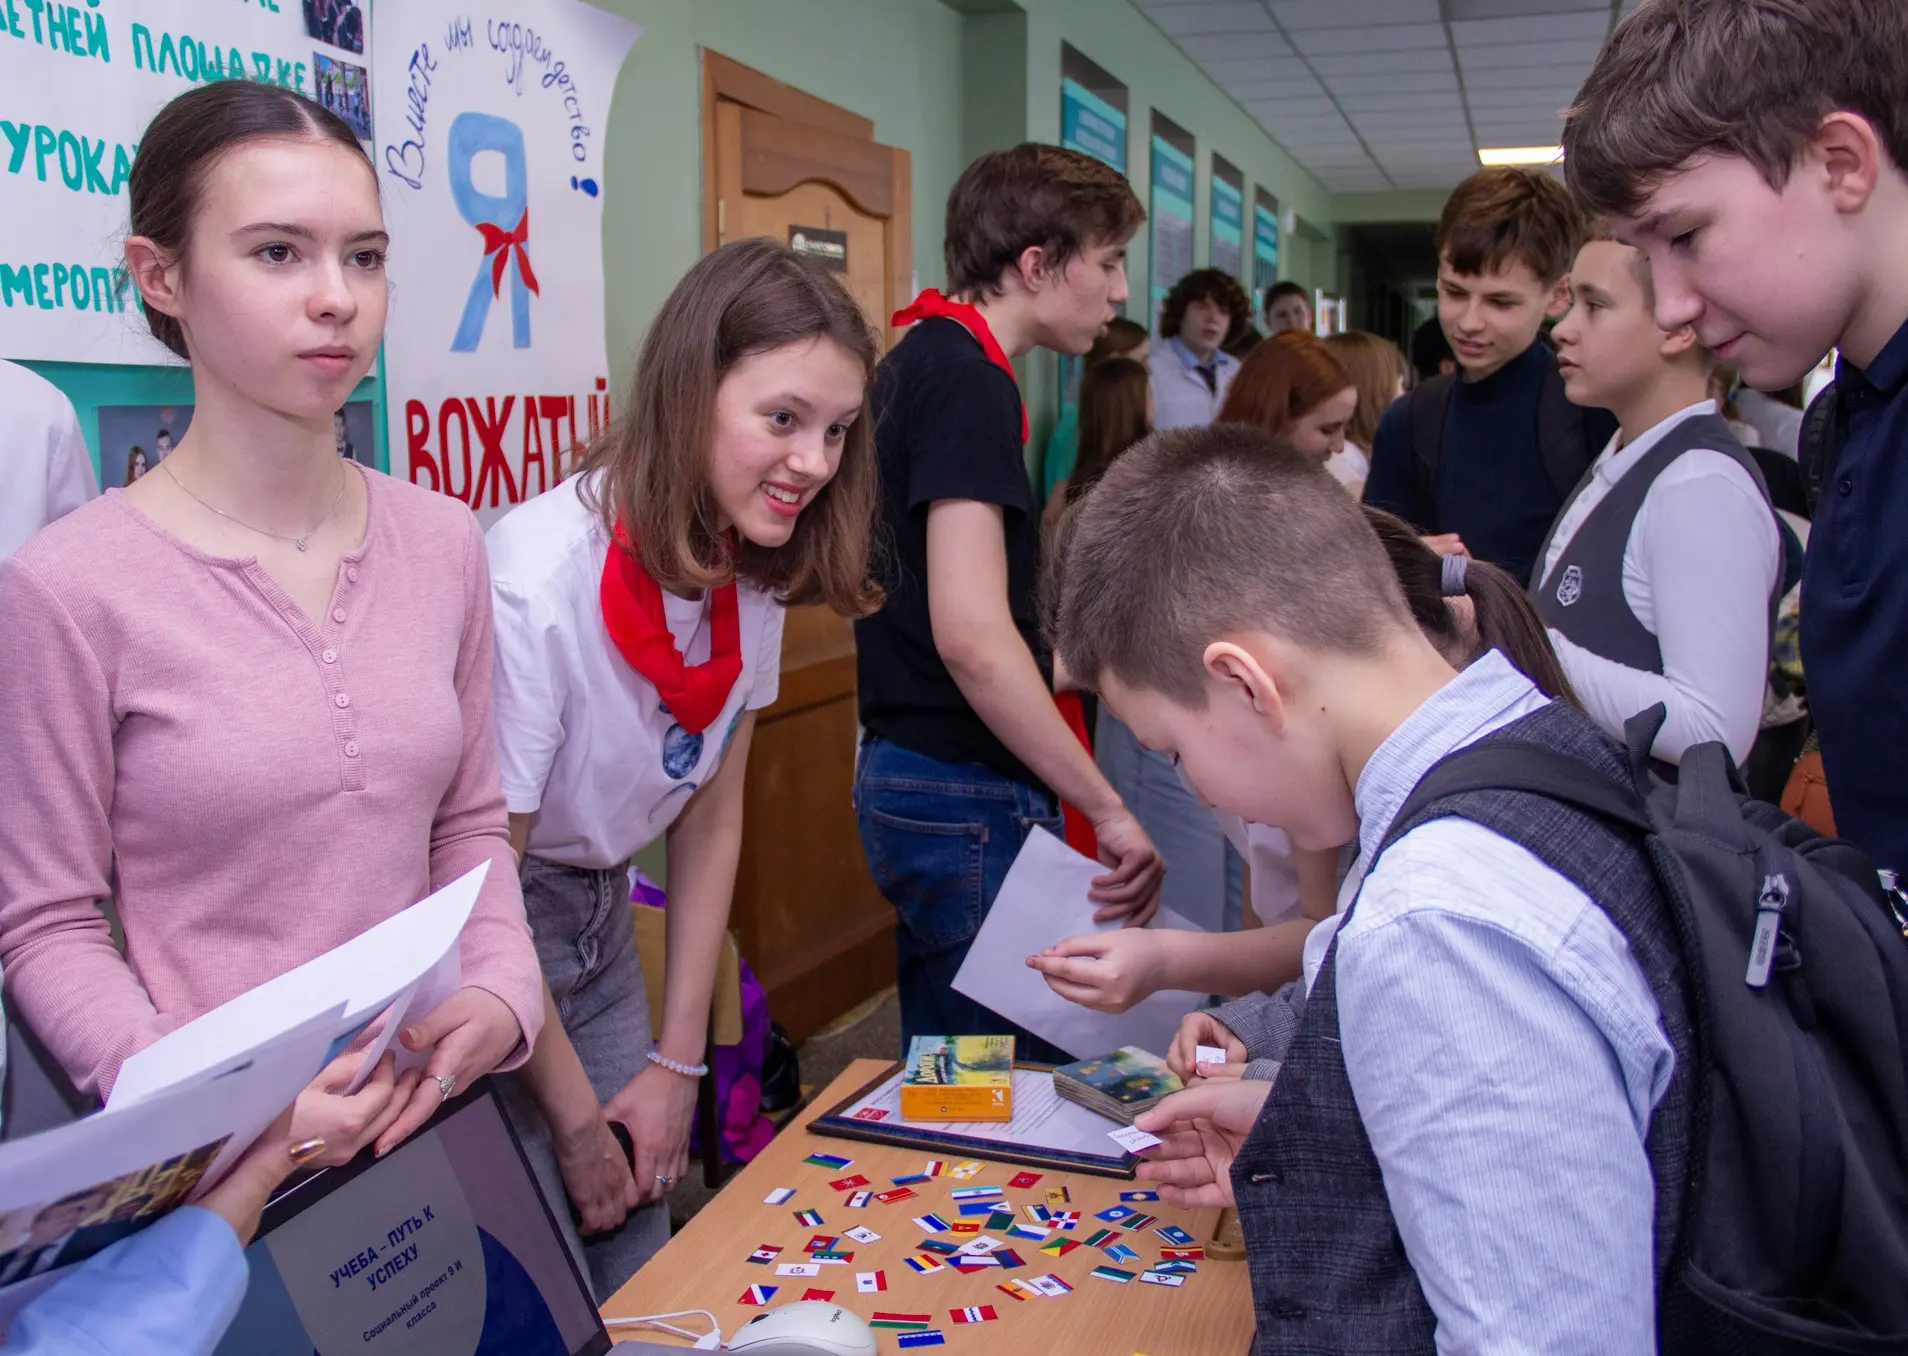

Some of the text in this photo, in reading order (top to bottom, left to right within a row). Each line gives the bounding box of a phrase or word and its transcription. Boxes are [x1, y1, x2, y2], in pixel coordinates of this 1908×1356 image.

[0, 120, 139, 196] УРОКА
[329, 1246, 380, 1289] УЧЕБА
[387, 1215, 423, 1248] ПУТЬ
[422, 1204, 435, 1222] К
[366, 1242, 419, 1292] УСПЕХУ
[362, 1293, 420, 1343] Социальный
[419, 1272, 449, 1300] проект
[447, 1265, 455, 1277] 9
[405, 1300, 438, 1330] класса
